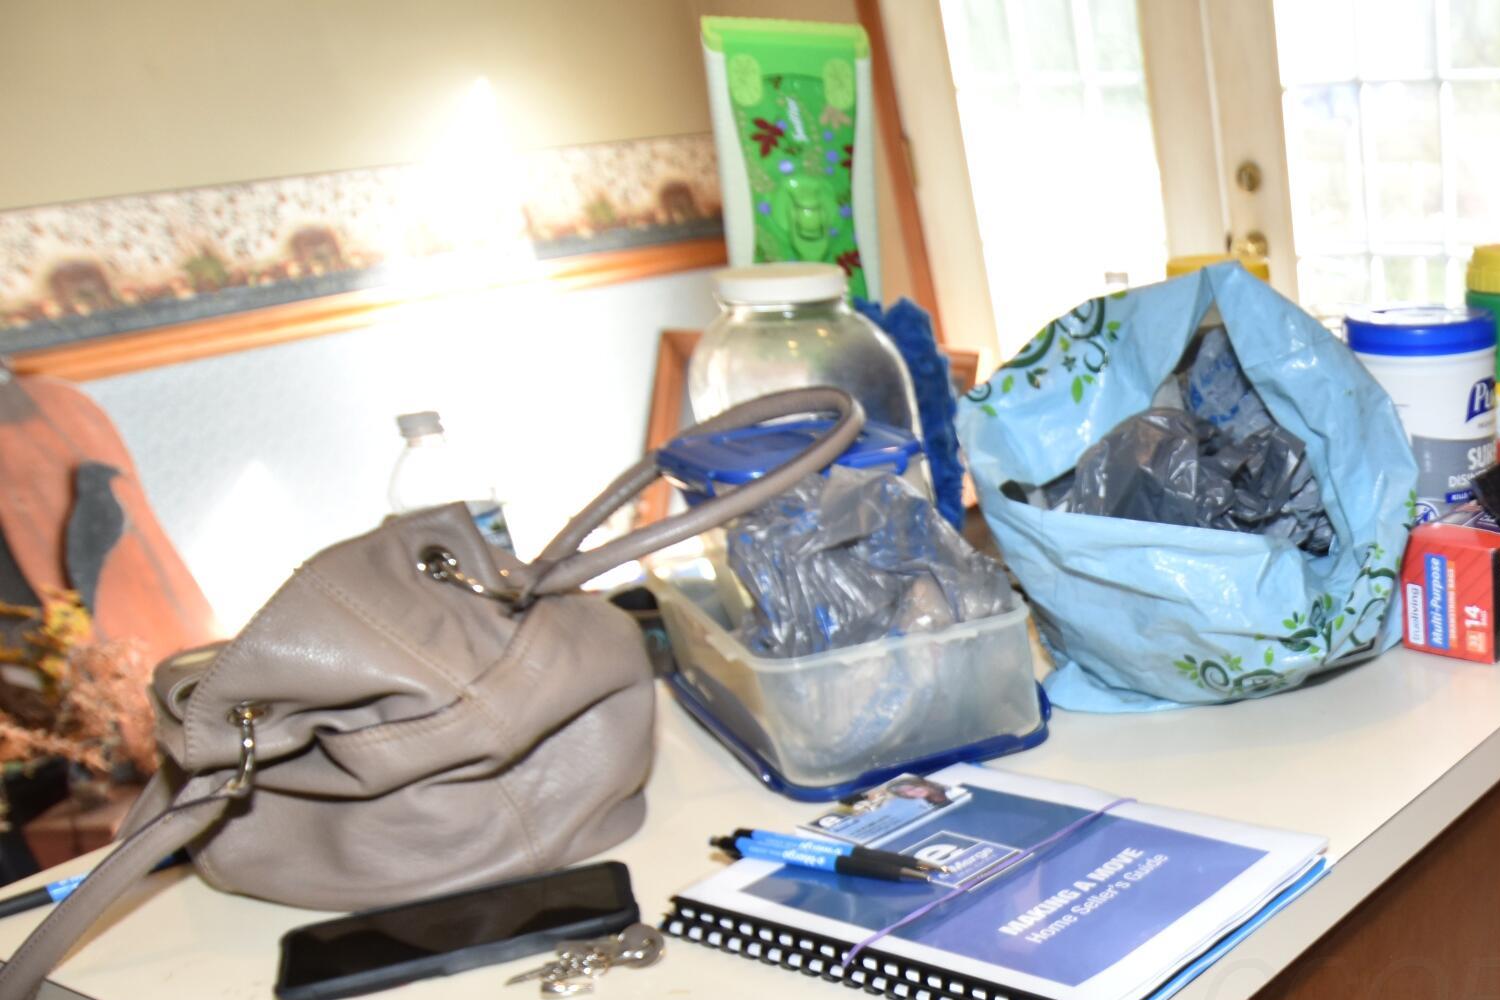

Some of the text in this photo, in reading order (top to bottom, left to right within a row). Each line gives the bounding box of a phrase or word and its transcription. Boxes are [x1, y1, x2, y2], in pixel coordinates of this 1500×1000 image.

[1429, 557, 1444, 645] Multi-Purpose
[1464, 605, 1480, 628] 14
[998, 847, 1144, 936] MAKING A MOVE
[1025, 853, 1169, 944] Home Seller's Guide
